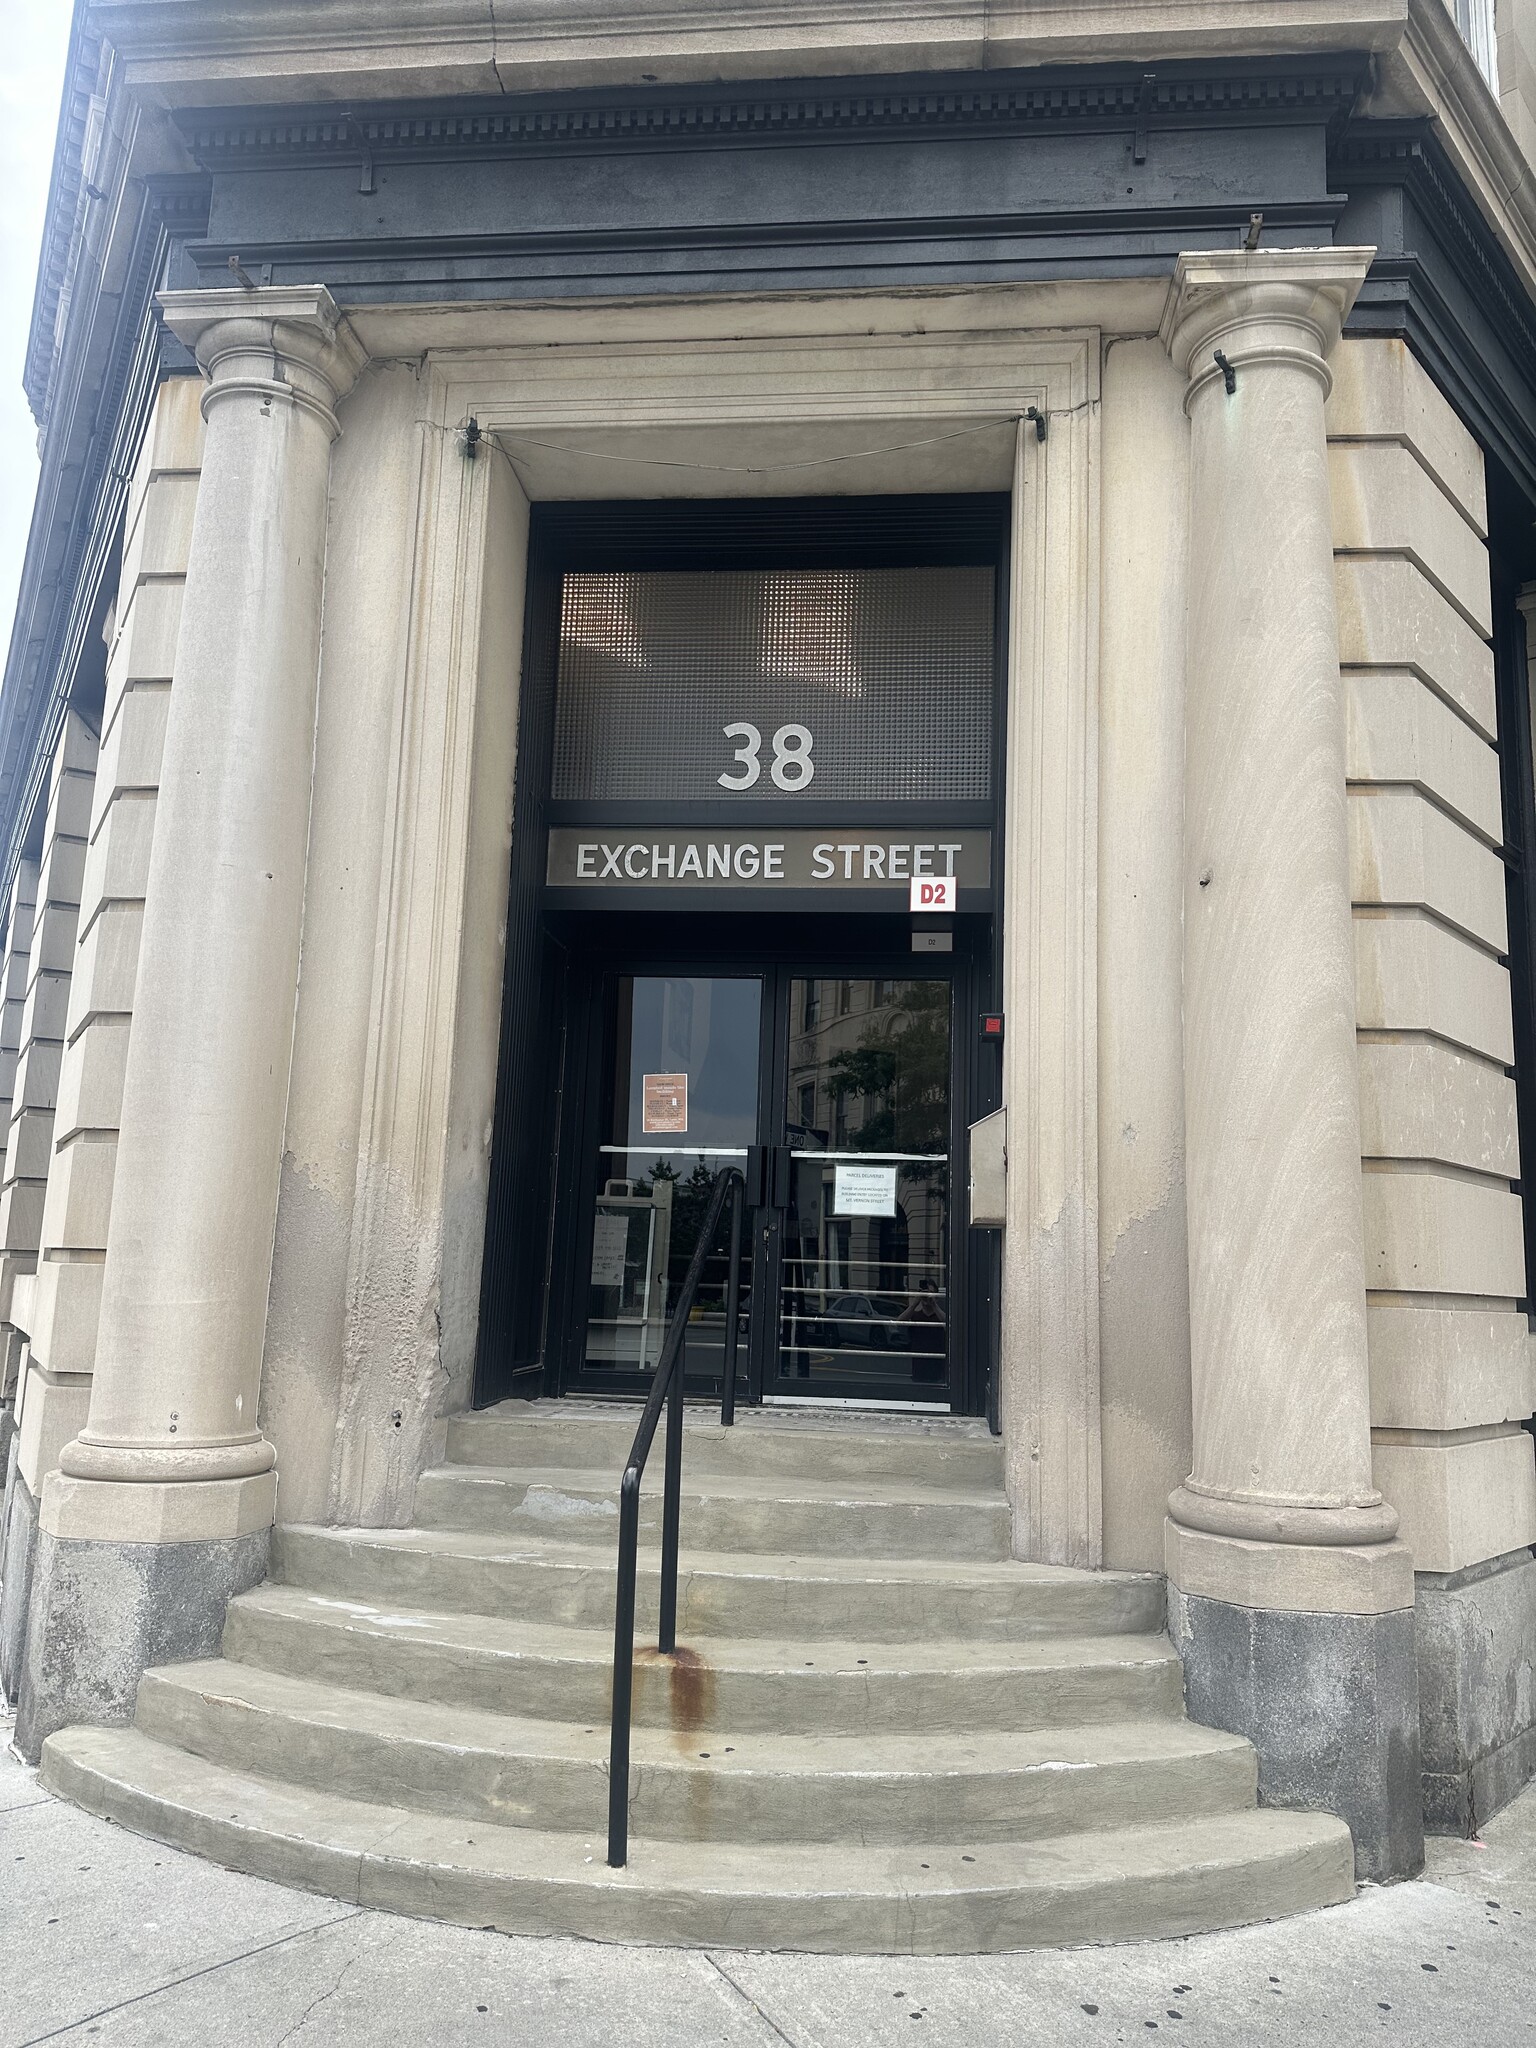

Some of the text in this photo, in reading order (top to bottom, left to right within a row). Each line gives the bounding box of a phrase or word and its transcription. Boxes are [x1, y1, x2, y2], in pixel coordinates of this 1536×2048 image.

[717, 722, 815, 792] 38
[576, 843, 962, 879] EXCHANGE STREET
[920, 884, 946, 904] D2
